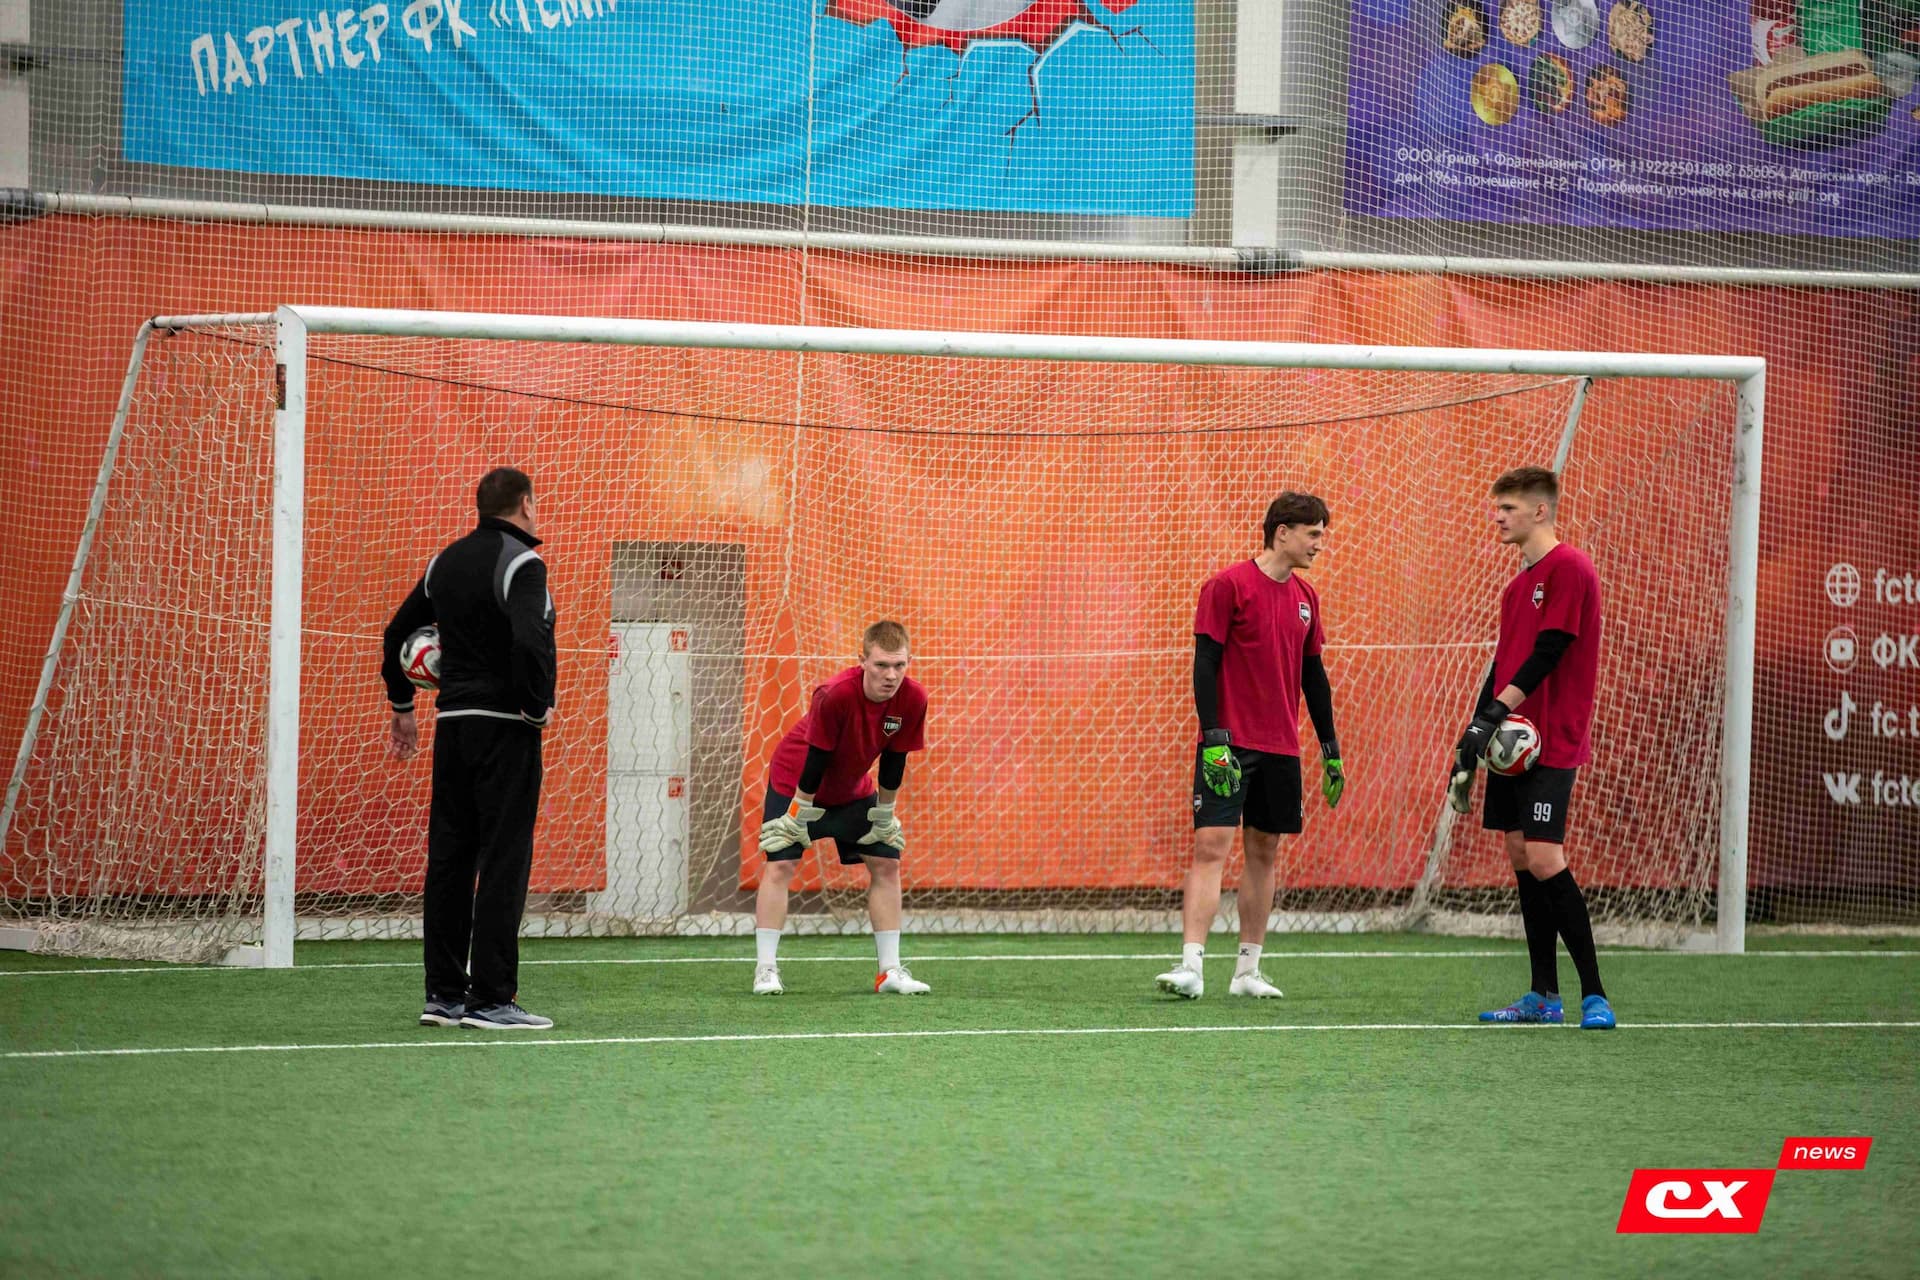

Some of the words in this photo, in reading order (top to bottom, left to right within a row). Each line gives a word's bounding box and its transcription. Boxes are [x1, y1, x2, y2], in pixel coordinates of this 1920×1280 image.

[191, 3, 390, 96] ПАРТНЕР
[402, 0, 477, 53] ФК
[1397, 147, 1433, 162] ООО
[1591, 157, 1626, 173] ОГРН
[1791, 167, 1854, 183] Алтайский
[1394, 172, 1423, 185] дом
[1465, 175, 1541, 190] помещение
[1577, 177, 1662, 195] Подробности
[1665, 184, 1730, 200] уточняйте
[1732, 188, 1749, 200] на
[1751, 186, 1785, 201] сайте
[1872, 633, 1920, 669] ФК
[1871, 701, 1920, 738] fc.t
[1533, 802, 1552, 822] 99
